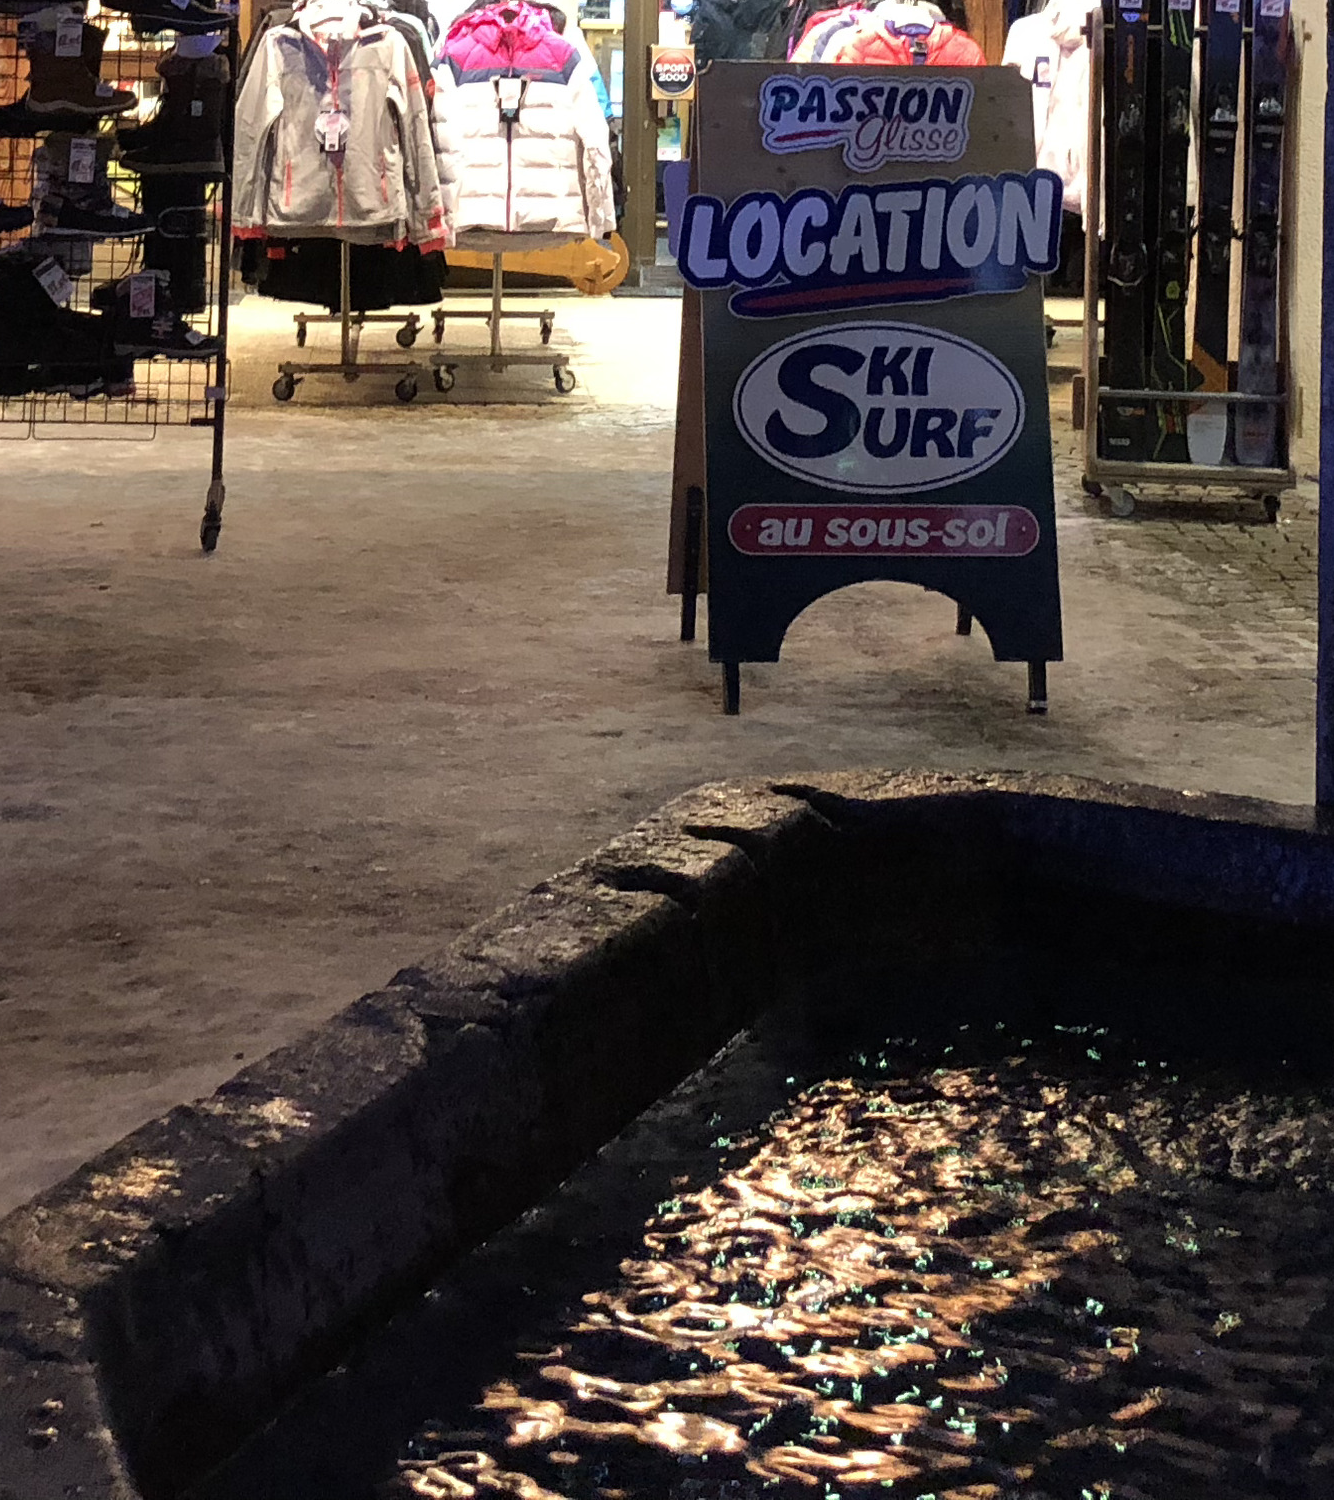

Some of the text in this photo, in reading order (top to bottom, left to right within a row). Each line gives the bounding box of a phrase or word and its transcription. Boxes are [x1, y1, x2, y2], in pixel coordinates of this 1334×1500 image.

[655, 63, 692, 73] SPORT
[658, 73, 689, 82] 2000
[770, 85, 963, 124] PASSION
[687, 177, 1055, 280] LOCATION
[758, 512, 1010, 547] au sous-sol
